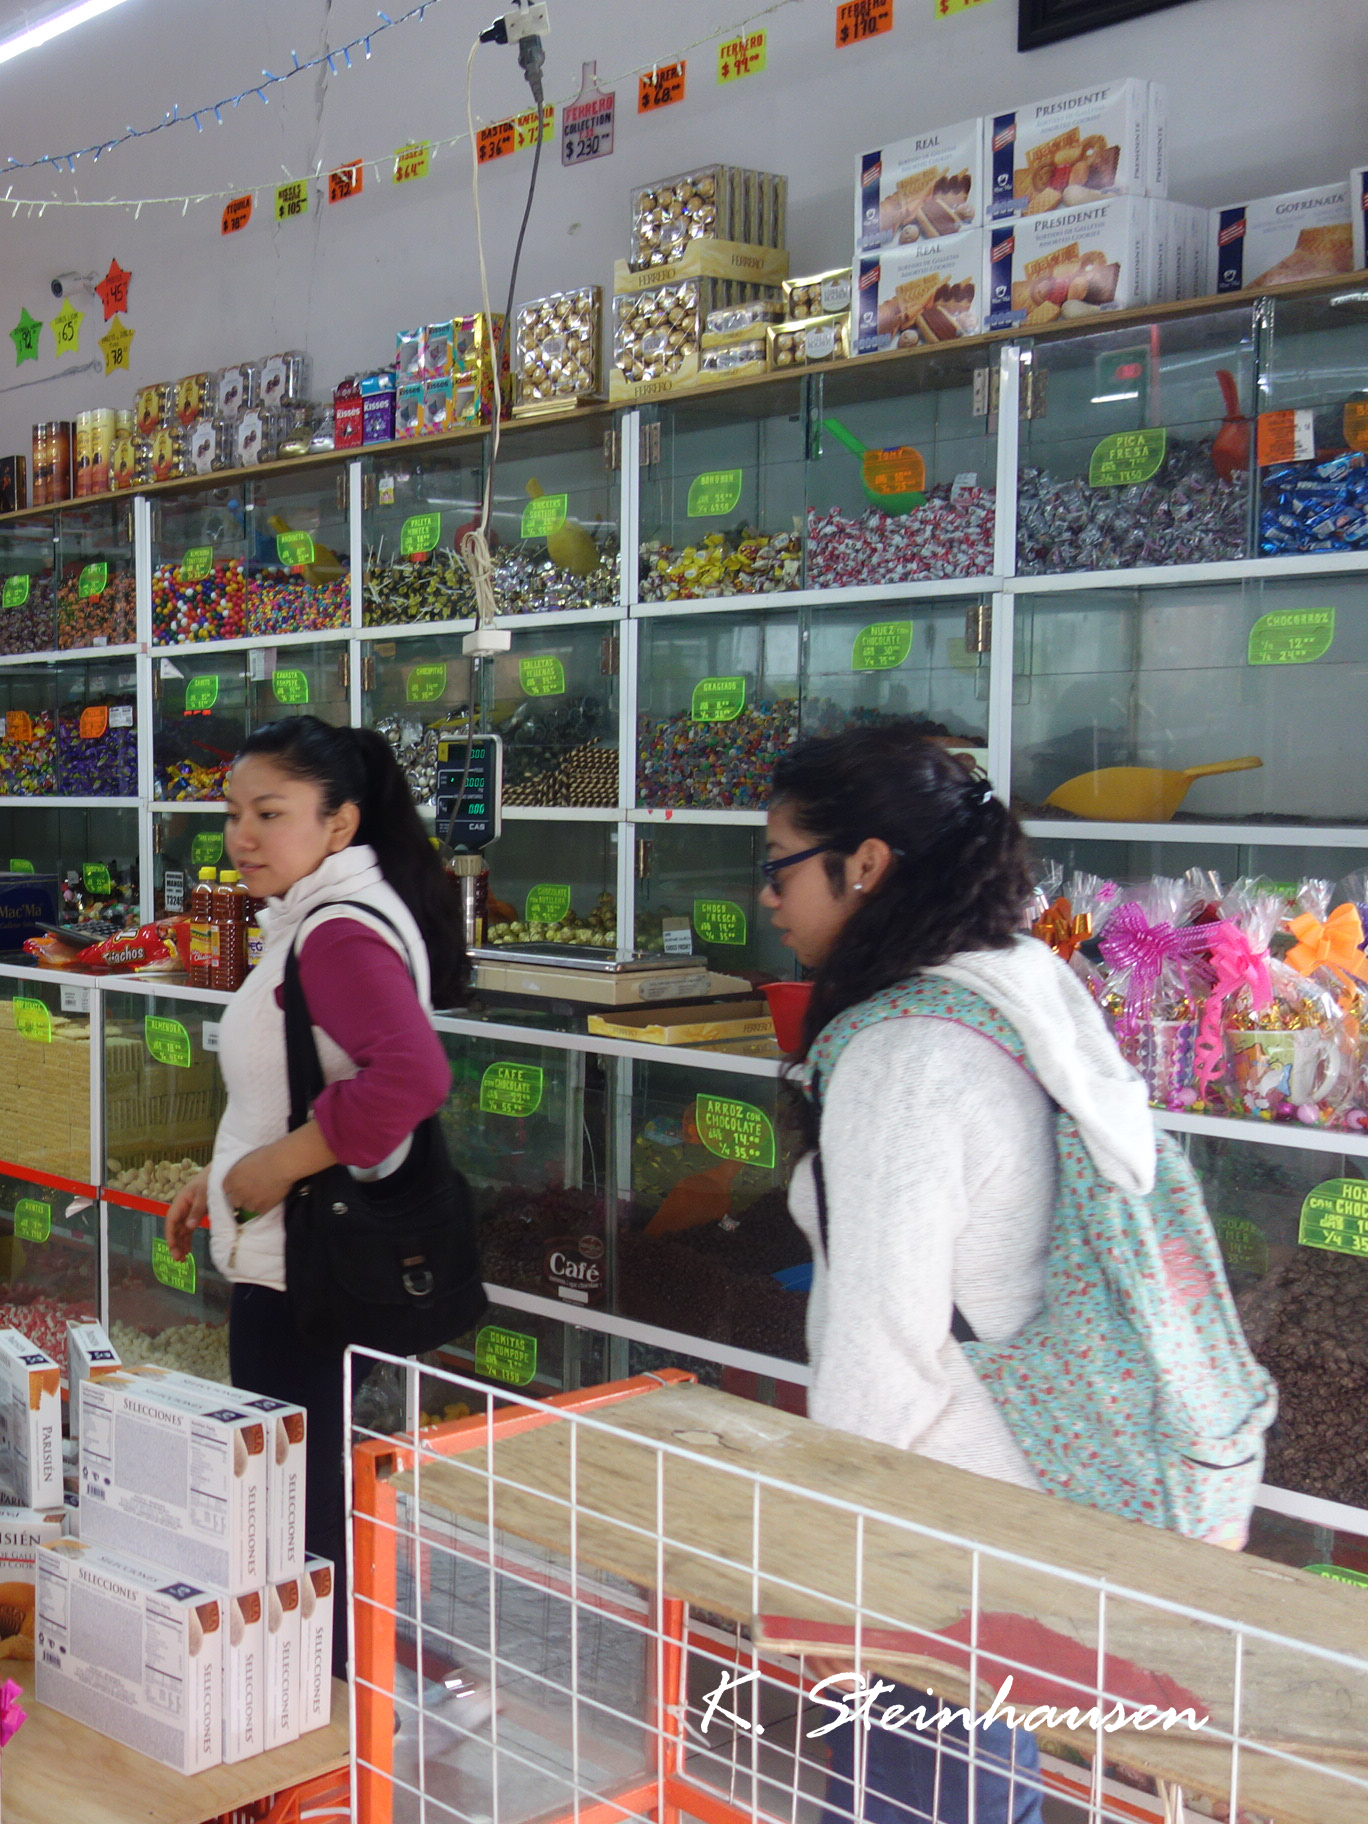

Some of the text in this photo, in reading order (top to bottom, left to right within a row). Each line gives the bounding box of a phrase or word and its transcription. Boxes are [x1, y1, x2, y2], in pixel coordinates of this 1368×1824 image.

[565, 96, 613, 122] FERRERO
[1034, 88, 1110, 119] PRESIDENTE
[564, 113, 612, 137] COLLECTION
[915, 135, 940, 151] REAL
[1275, 194, 1345, 215] GOFRENATA
[1033, 205, 1110, 232] PRESIDENTE
[915, 243, 942, 258] REAL
[731, 254, 765, 270] FERRERO
[638, 267, 677, 287] FERRERO
[634, 379, 673, 398] FERRERO
[1116, 436, 1146, 448] PICA
[1109, 447, 1149, 460] FRESA
[871, 625, 895, 637] NUEZ
[468, 822, 486, 831] CAS
[701, 903, 727, 914] CHOCO
[151, 1020, 182, 1034] ALMENDRA
[498, 1068, 524, 1081] CAFE
[707, 1100, 744, 1119] ARROZ
[705, 1113, 762, 1137] CHOCOLATE
[549, 1251, 601, 1283] Café
[490, 1331, 526, 1350] GOMITAS
[123, 1398, 183, 1428] SELECCIONES
[41, 1425, 53, 1483] PARISIÉN
[286, 1473, 297, 1564] SELECCIONES
[247, 1484, 257, 1577] SELECCIONES
[78, 1568, 140, 1602] SELECCIONES
[313, 1626, 322, 1715] SELECCIONES
[280, 1640, 291, 1730] SELECCIONES
[203, 1662, 212, 1756] SELECCIONES
[245, 1652, 254, 1744] SELECCIONES
